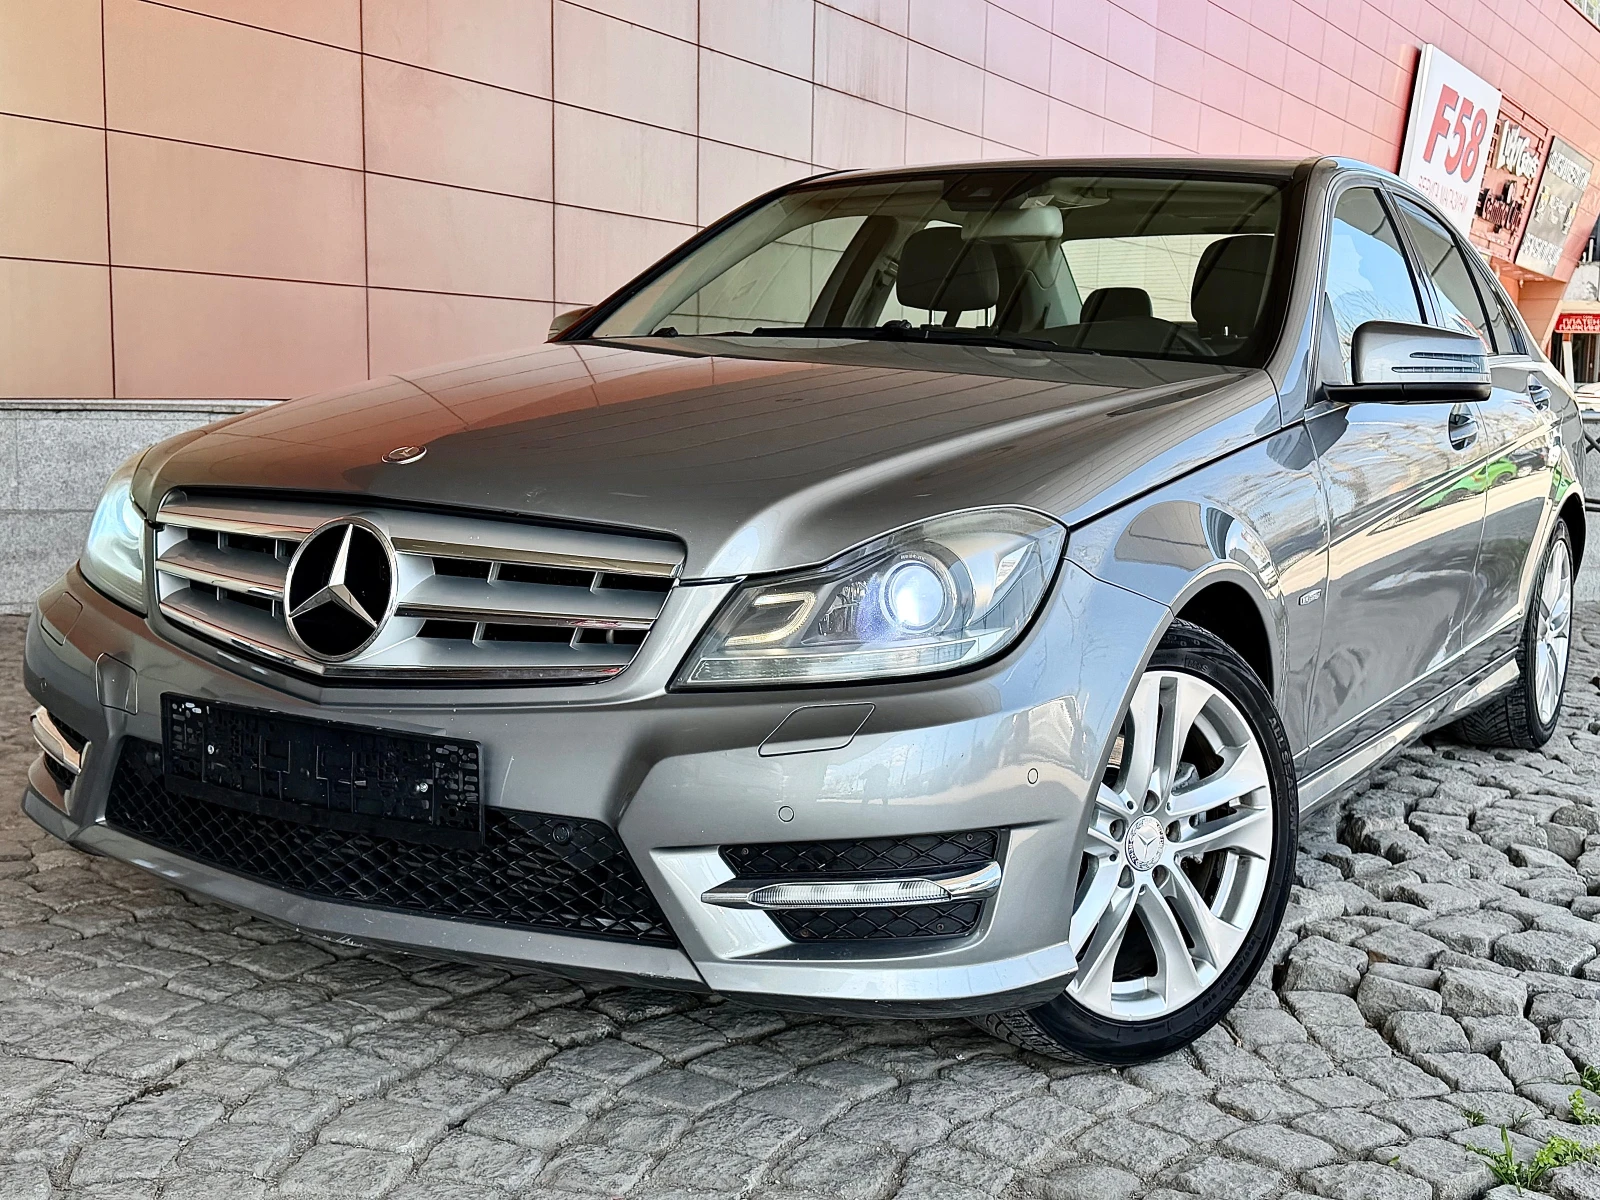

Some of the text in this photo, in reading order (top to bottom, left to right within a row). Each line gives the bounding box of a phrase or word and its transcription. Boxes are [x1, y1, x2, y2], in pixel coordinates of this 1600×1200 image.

[1423, 84, 1487, 183] F58
[1268, 716, 1299, 831] ALL SEASON
